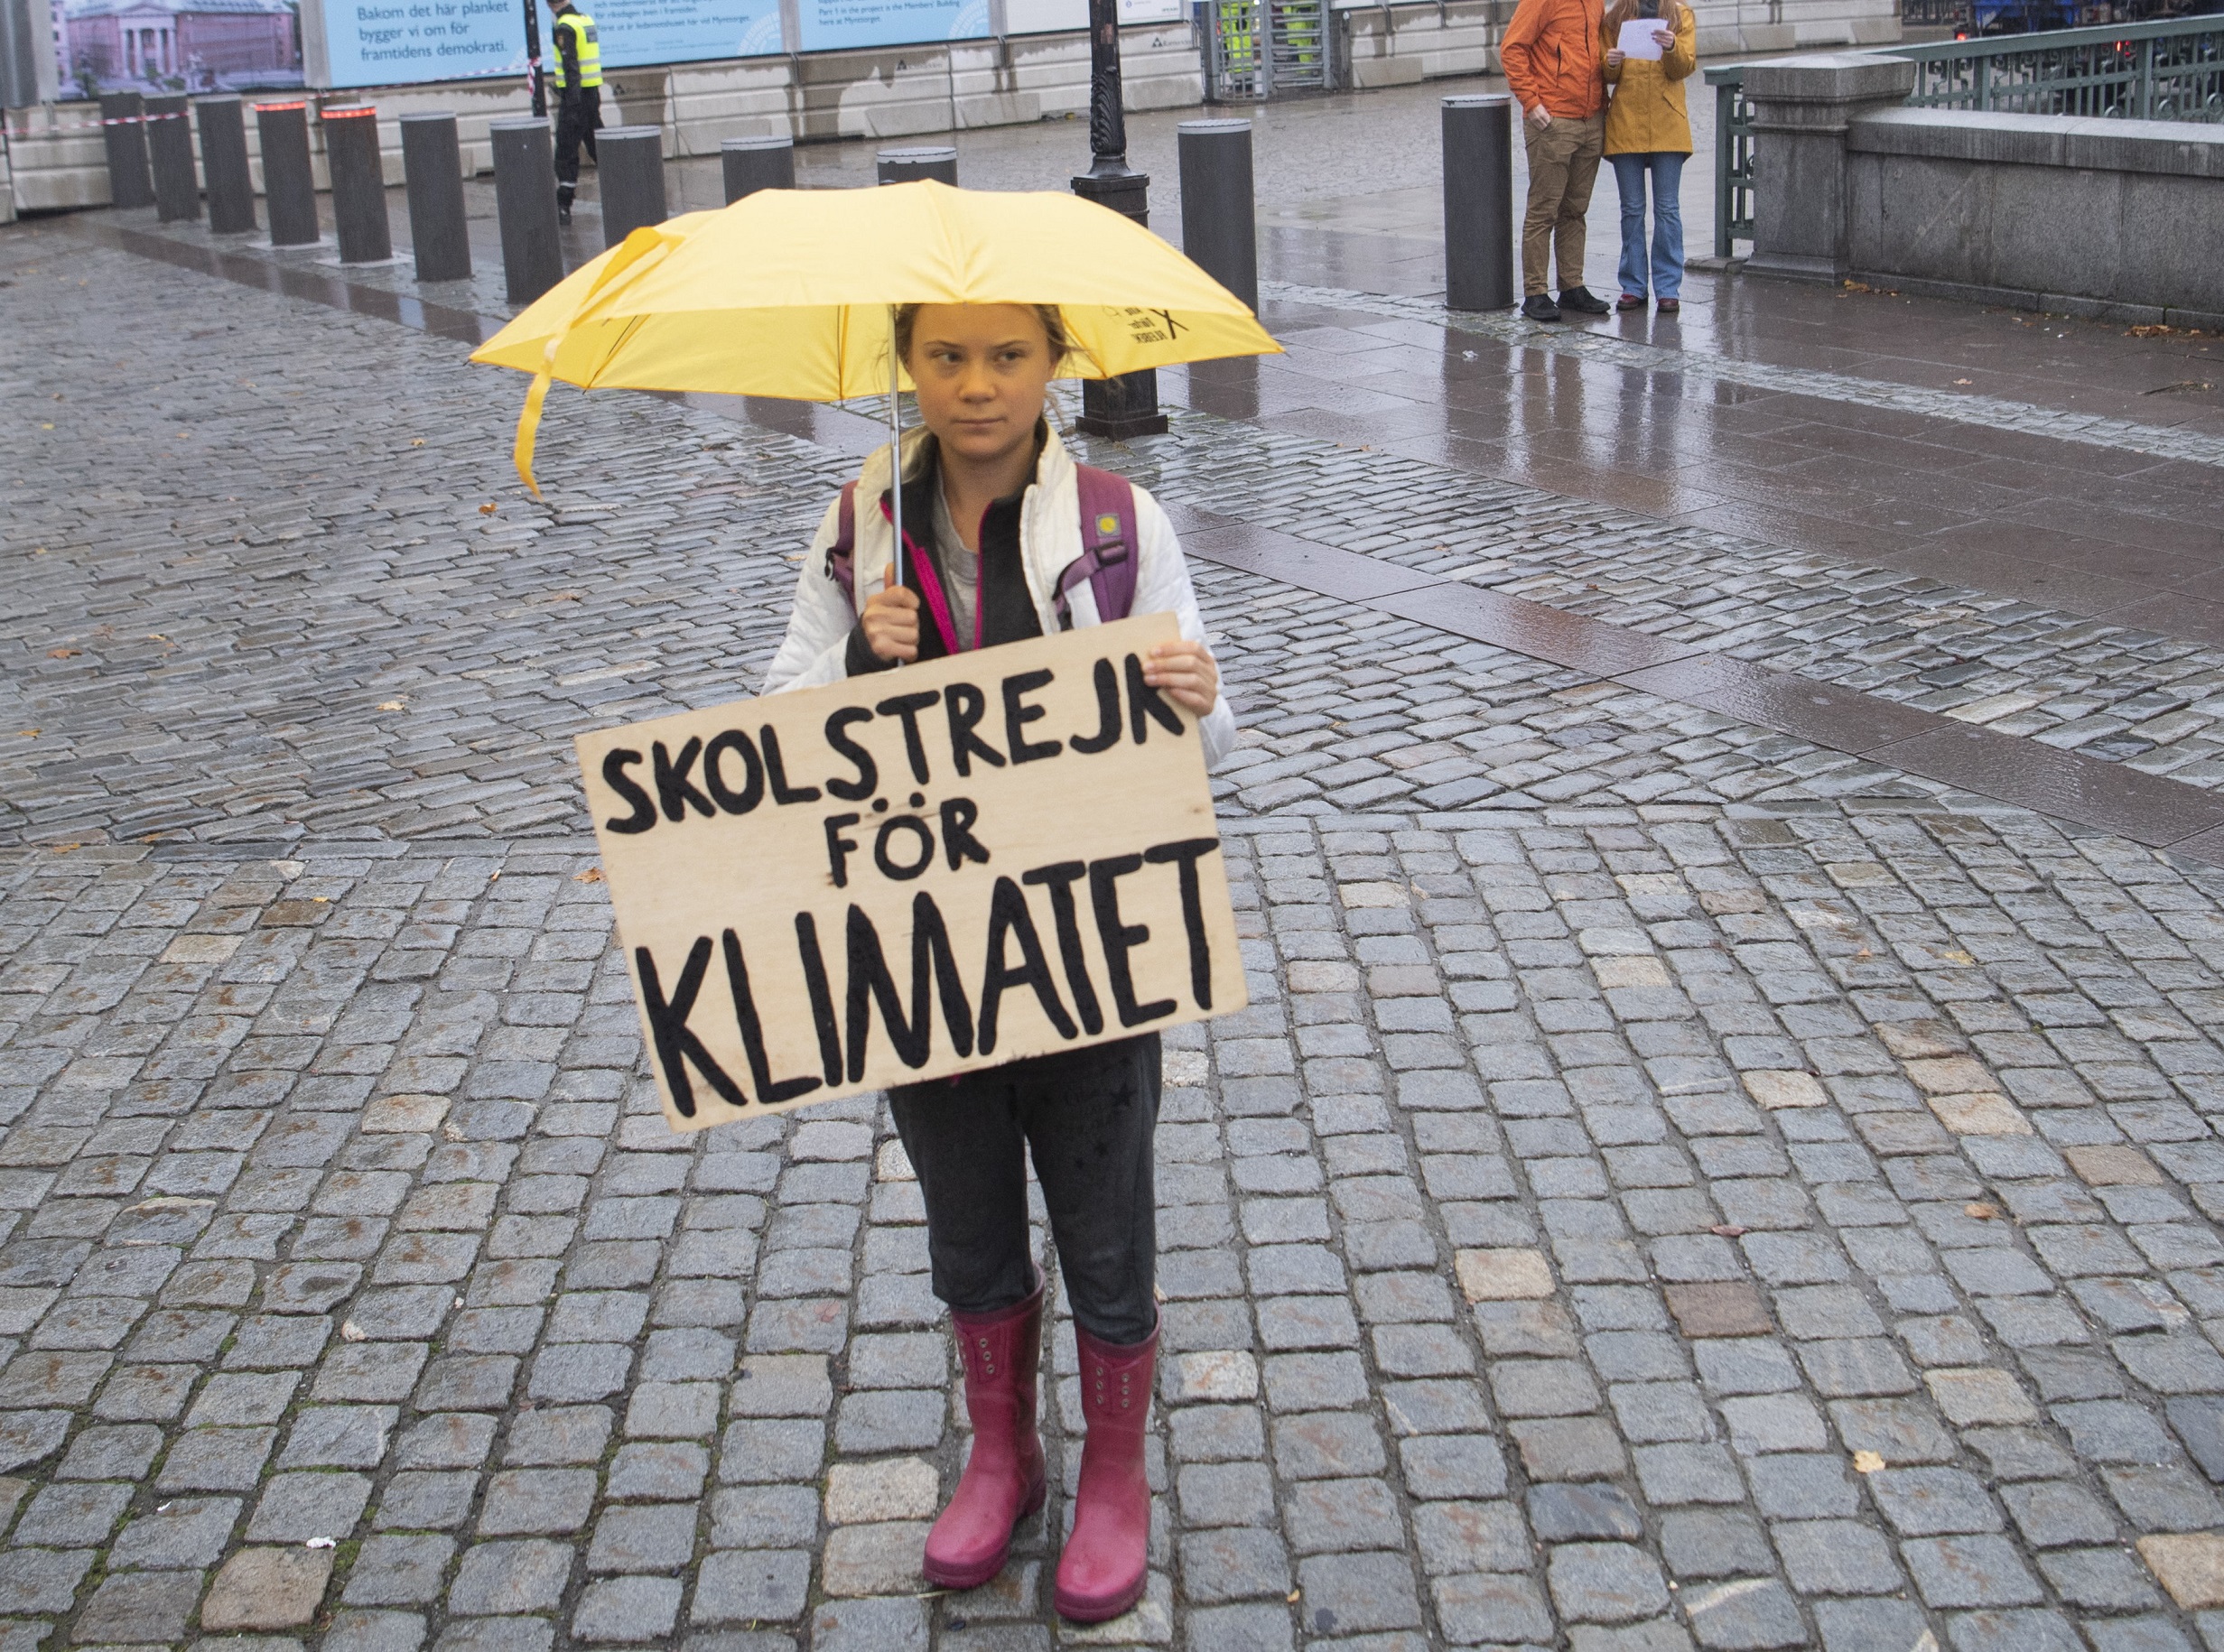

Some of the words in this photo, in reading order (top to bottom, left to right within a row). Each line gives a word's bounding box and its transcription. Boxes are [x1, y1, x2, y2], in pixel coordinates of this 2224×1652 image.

[357, 6, 405, 21] Bakom
[409, 5, 431, 17] det
[435, 4, 456, 15] här
[462, 0, 510, 18] planket
[358, 28, 403, 43] bygger
[408, 25, 420, 37] vi
[423, 26, 446, 36] om
[450, 21, 470, 34] för
[361, 44, 432, 60] framtidens
[436, 41, 507, 56] demokrati.
[601, 653, 1185, 835] SKOLSTREJK
[824, 792, 991, 889] FÖR
[635, 837, 1220, 1118] KLIMATET
